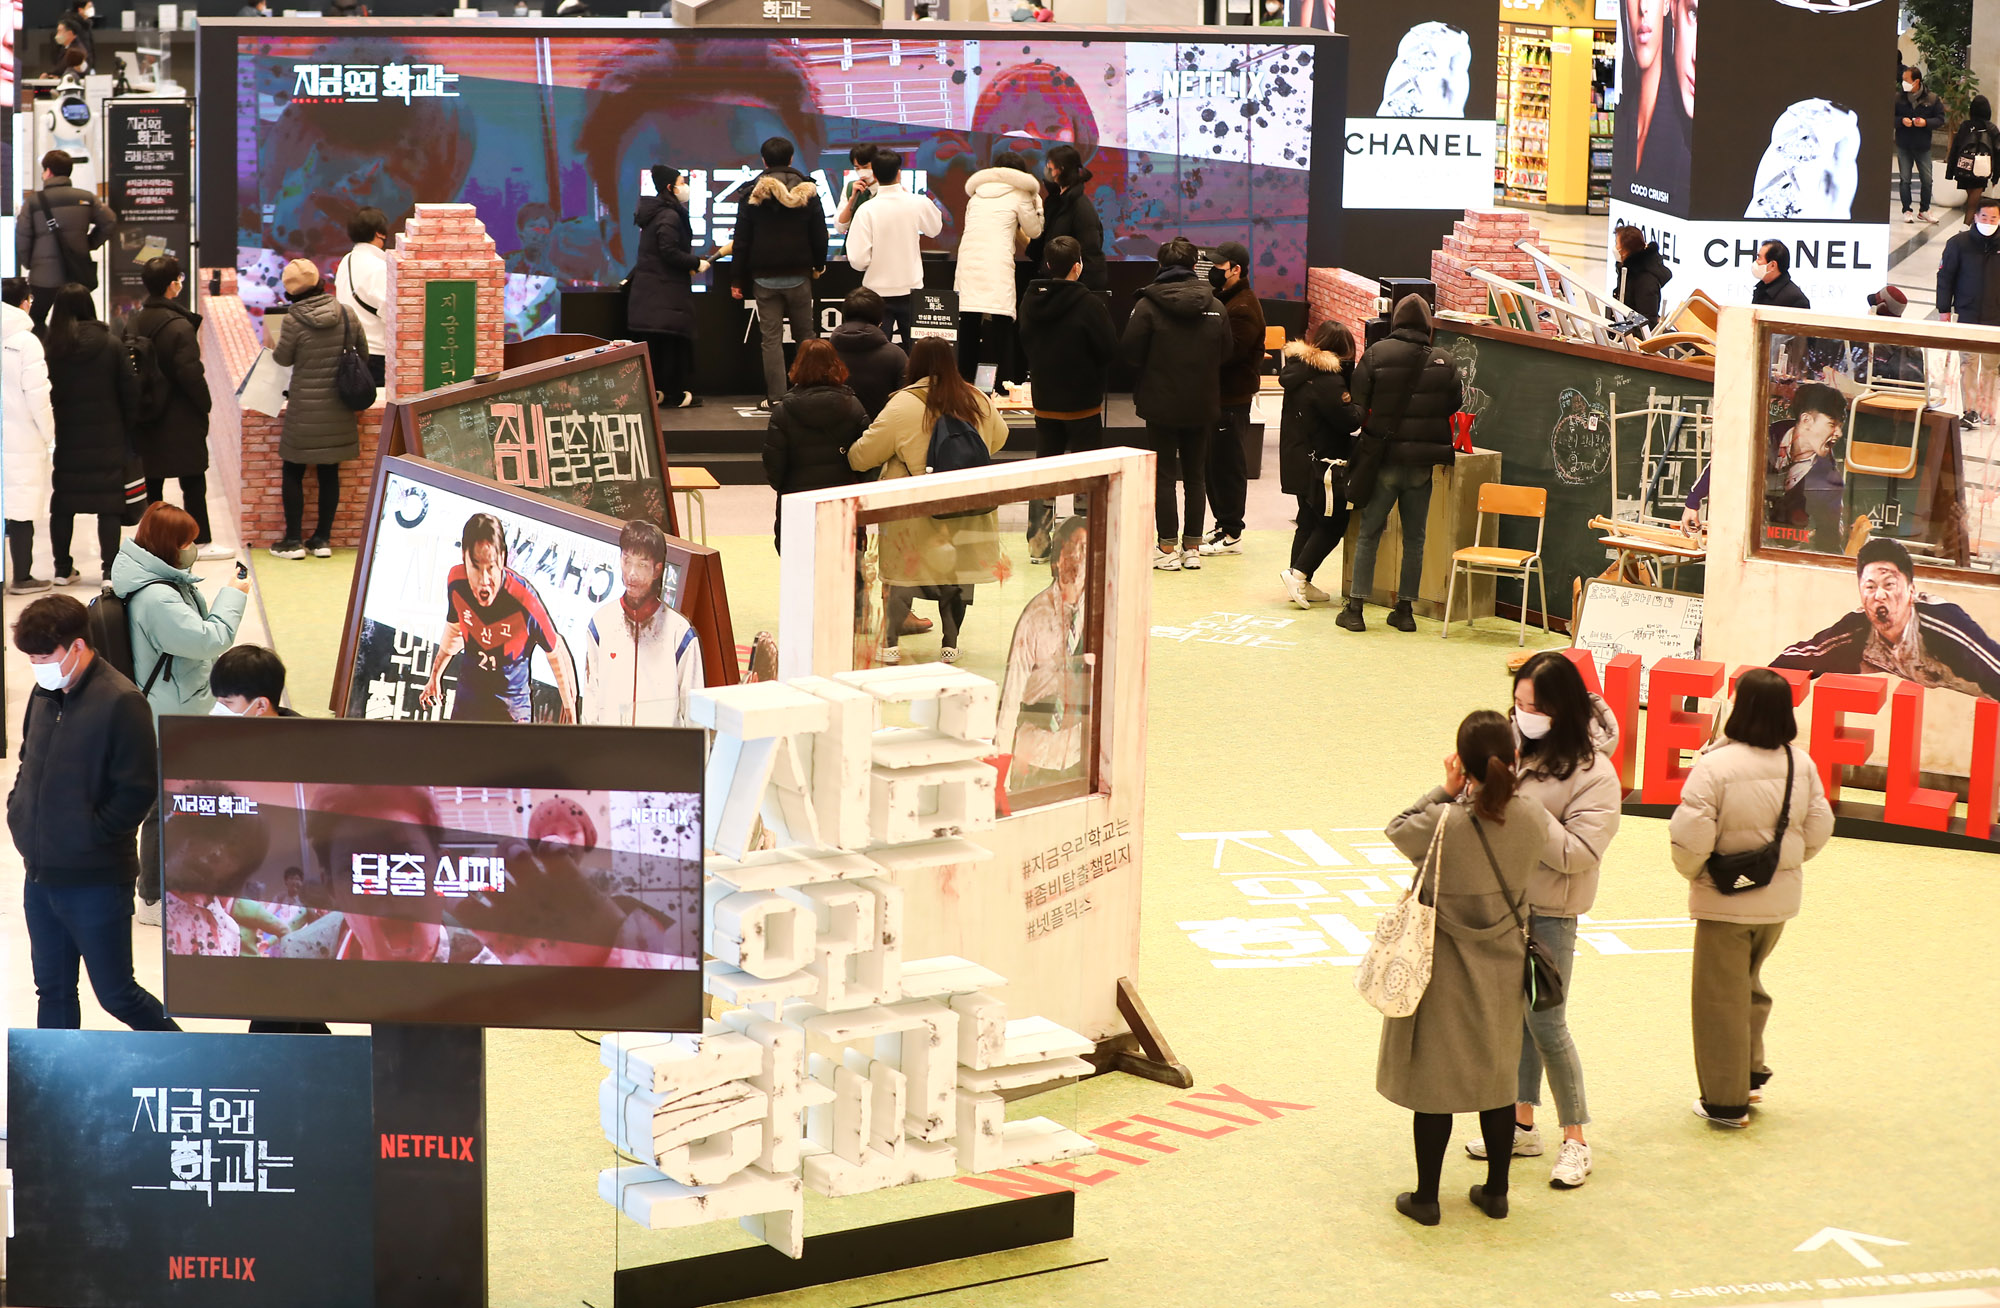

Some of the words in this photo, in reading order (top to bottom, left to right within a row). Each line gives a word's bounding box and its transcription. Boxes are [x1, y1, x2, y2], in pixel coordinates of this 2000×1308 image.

[1162, 69, 1266, 101] NETFLIX
[1345, 132, 1482, 158] CHANEL
[1630, 182, 1647, 198] COCO
[1648, 187, 1669, 204] CRUSH
[1704, 238, 1872, 269] CHNEL
[1767, 526, 1810, 543] NETFLIX
[631, 808, 689, 826] NETFLIX
[1022, 817, 1131, 881] #지금우리학교는
[352, 853, 425, 896] 탈출
[433, 856, 505, 897] 실패
[1024, 843, 1132, 911] #좀비탈출챌린지
[1027, 897, 1093, 940] #넷플릭스
[132, 1087, 202, 1134] 지금
[208, 1091, 257, 1135] 우리
[381, 1133, 475, 1163] NETFLIX
[168, 1135, 296, 1207] 학교는
[169, 1256, 256, 1282] NETFLIX
